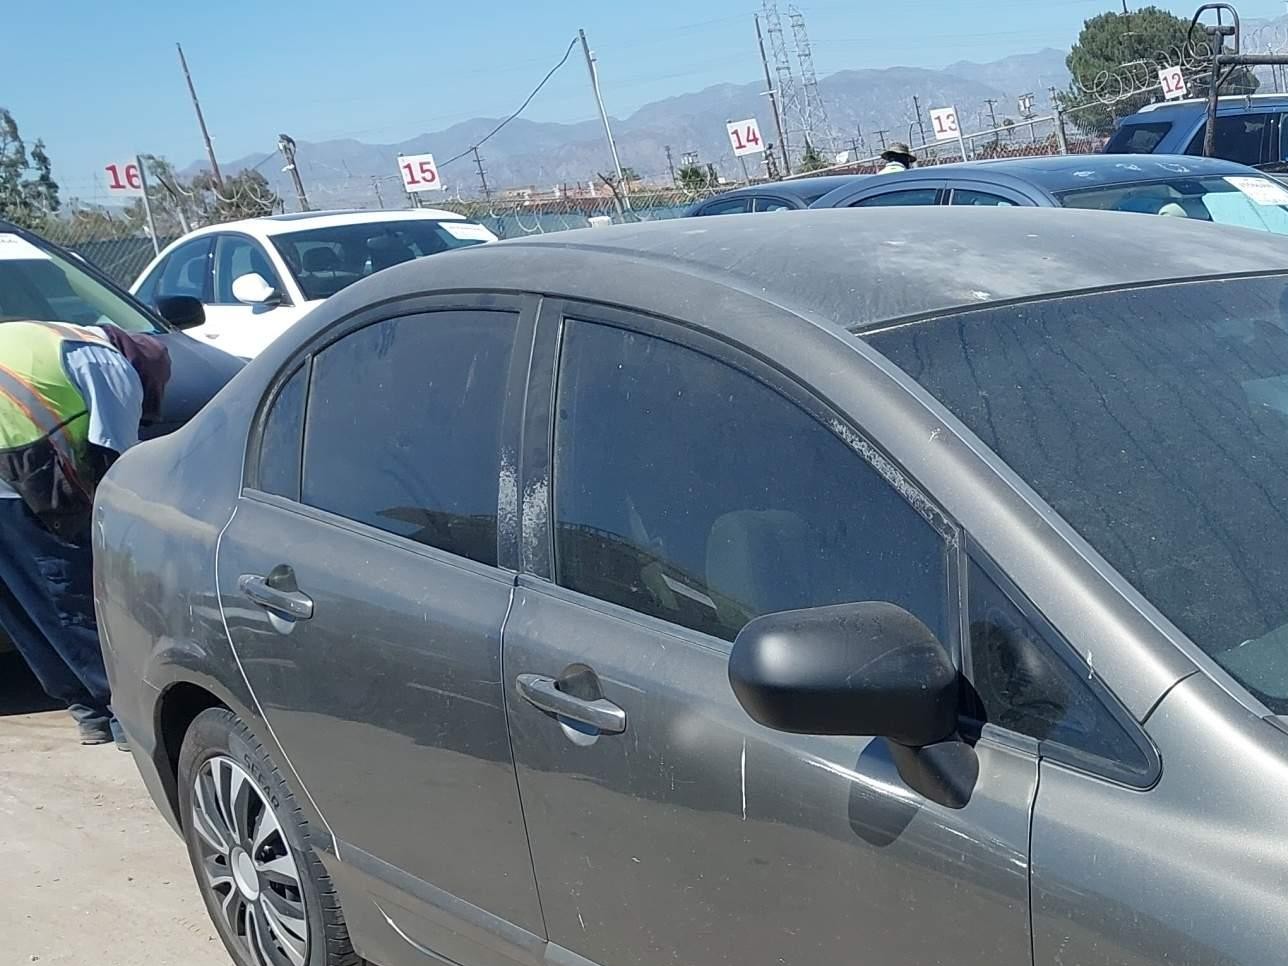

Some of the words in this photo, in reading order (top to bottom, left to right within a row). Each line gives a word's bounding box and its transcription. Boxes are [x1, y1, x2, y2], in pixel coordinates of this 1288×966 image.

[1162, 73, 1184, 93] 12
[934, 113, 957, 133] 13
[731, 126, 760, 149] 14
[105, 164, 141, 189] 16
[403, 161, 436, 185] 15
